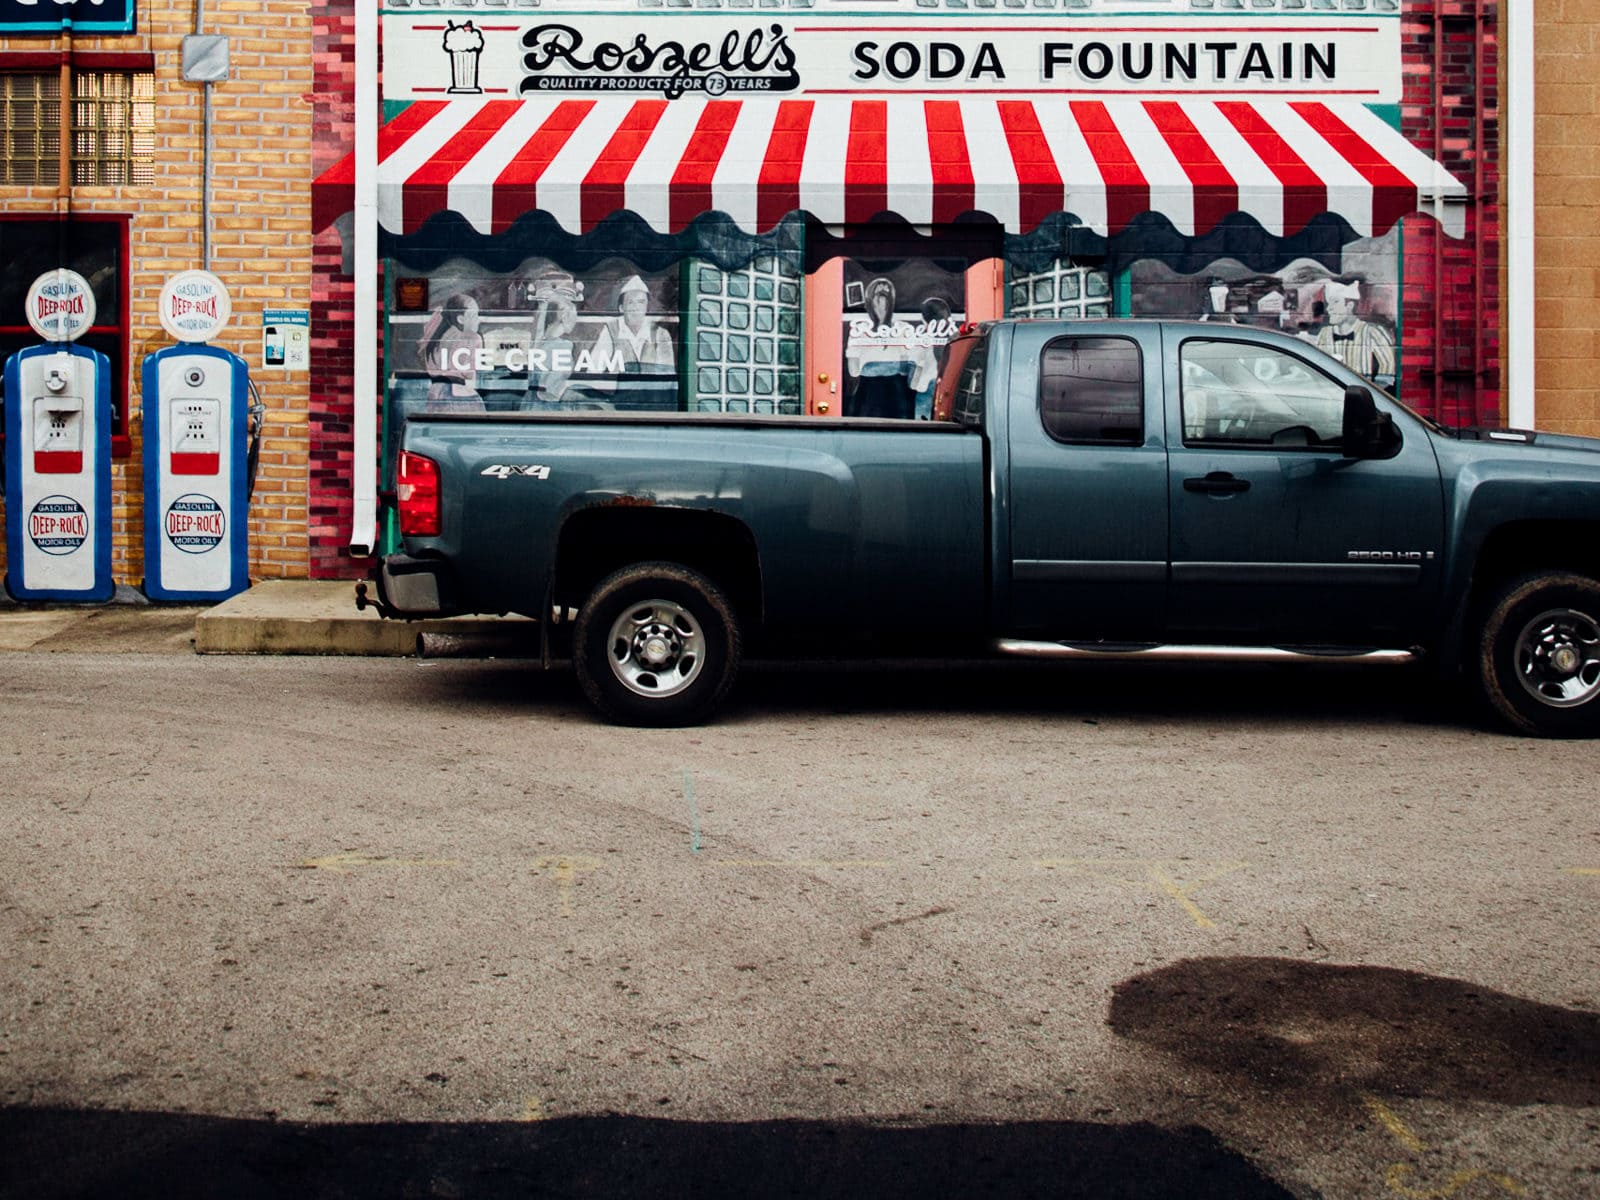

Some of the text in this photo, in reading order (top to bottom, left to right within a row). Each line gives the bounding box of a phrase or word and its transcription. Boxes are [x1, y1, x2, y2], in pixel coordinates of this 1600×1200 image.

[522, 23, 797, 100] Roszell's
[854, 41, 1337, 80] SODA FOUNTAIN
[539, 78, 772, 90] QUALITY PRODUCTS FOR 73 YEARS
[176, 283, 213, 297] GASOLINE
[171, 294, 218, 319] DEEP-ROCK
[440, 348, 626, 372] ICE CREAM
[38, 504, 78, 512] GASOLINE
[33, 514, 84, 537] DEEP-ROCK
[170, 512, 221, 535] DEEP-ROCK
